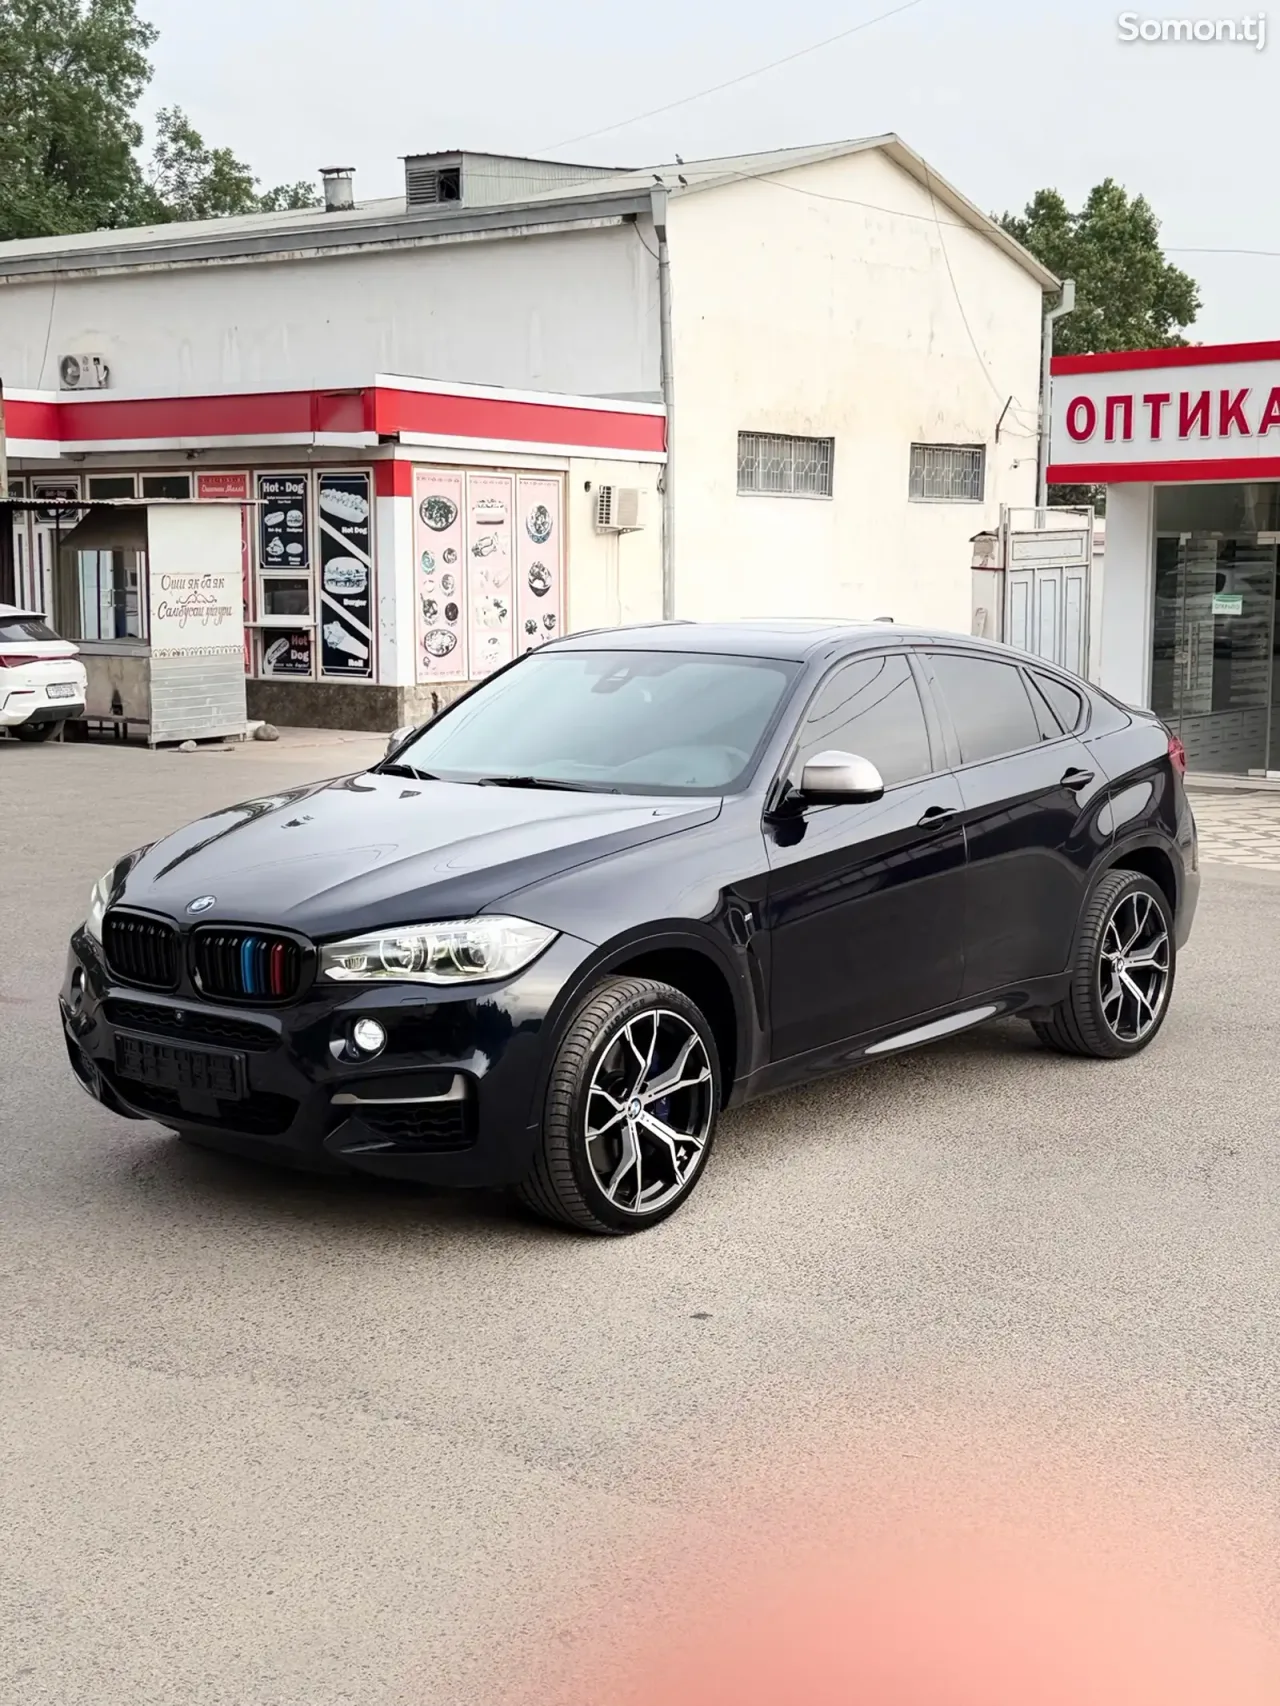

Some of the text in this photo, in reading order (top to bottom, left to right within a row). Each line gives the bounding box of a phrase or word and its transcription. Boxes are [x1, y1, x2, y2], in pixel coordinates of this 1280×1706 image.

[1066, 386, 1280, 442] ОПТИКА
[263, 482, 304, 494] Hot Dog
[341, 526, 368, 535] Hot Dog
[291, 634, 308, 646] Hot
[290, 649, 309, 662] Dog
